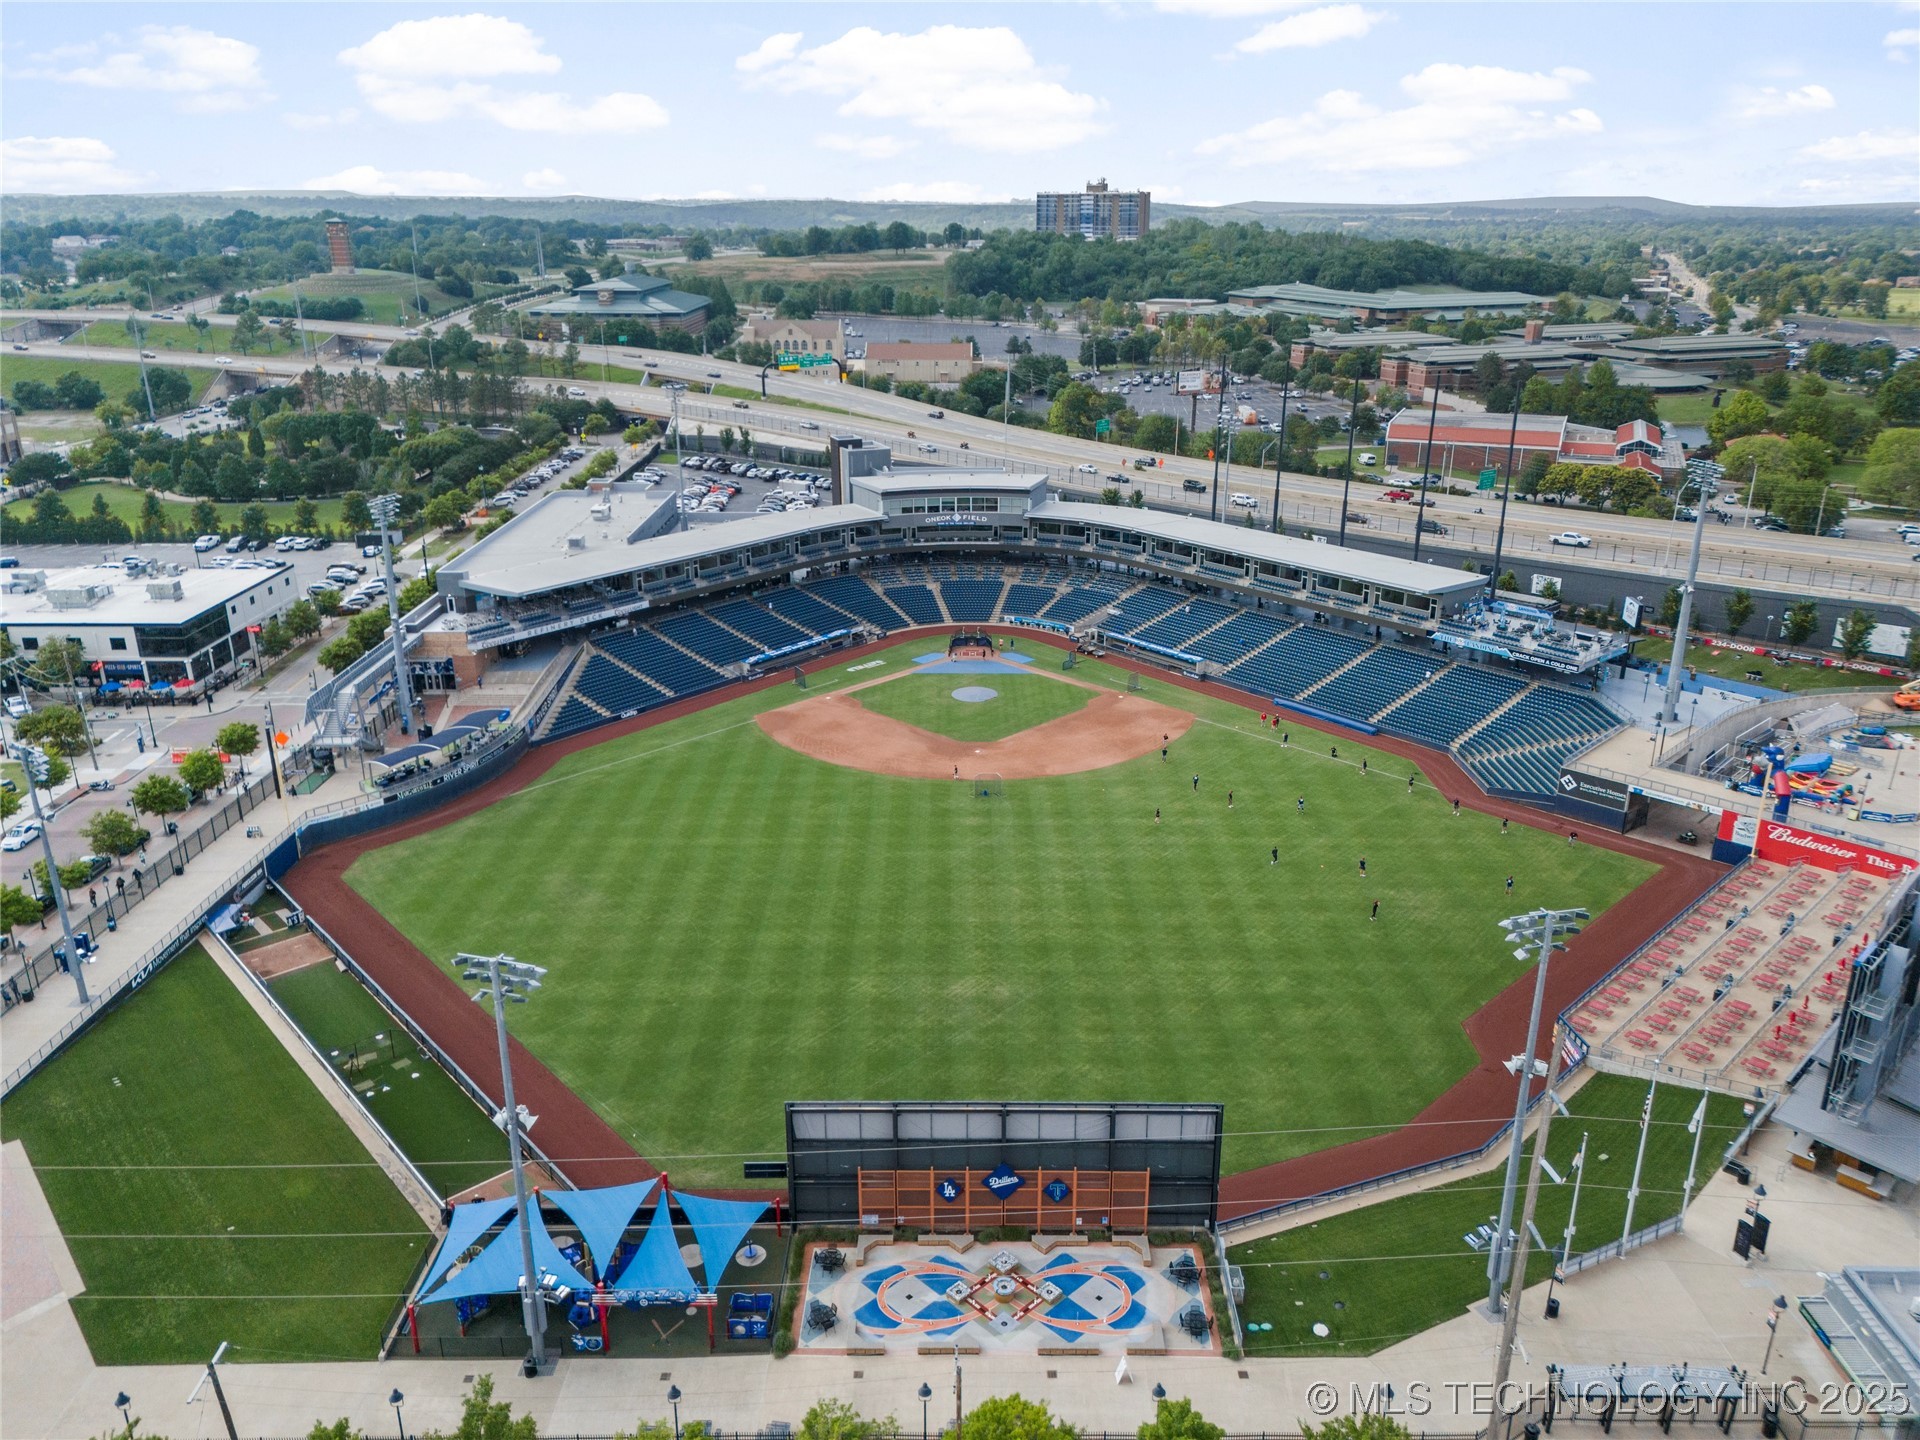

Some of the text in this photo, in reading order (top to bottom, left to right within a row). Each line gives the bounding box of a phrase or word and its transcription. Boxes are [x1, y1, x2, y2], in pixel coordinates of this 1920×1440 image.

[925, 515, 951, 523] ONEOK
[962, 514, 988, 522] FIELD
[1711, 640, 1756, 653] 234-DOOR
[1606, 787, 1627, 799] Homes
[1767, 824, 1856, 859] Budweiser
[1866, 854, 1896, 871] This
